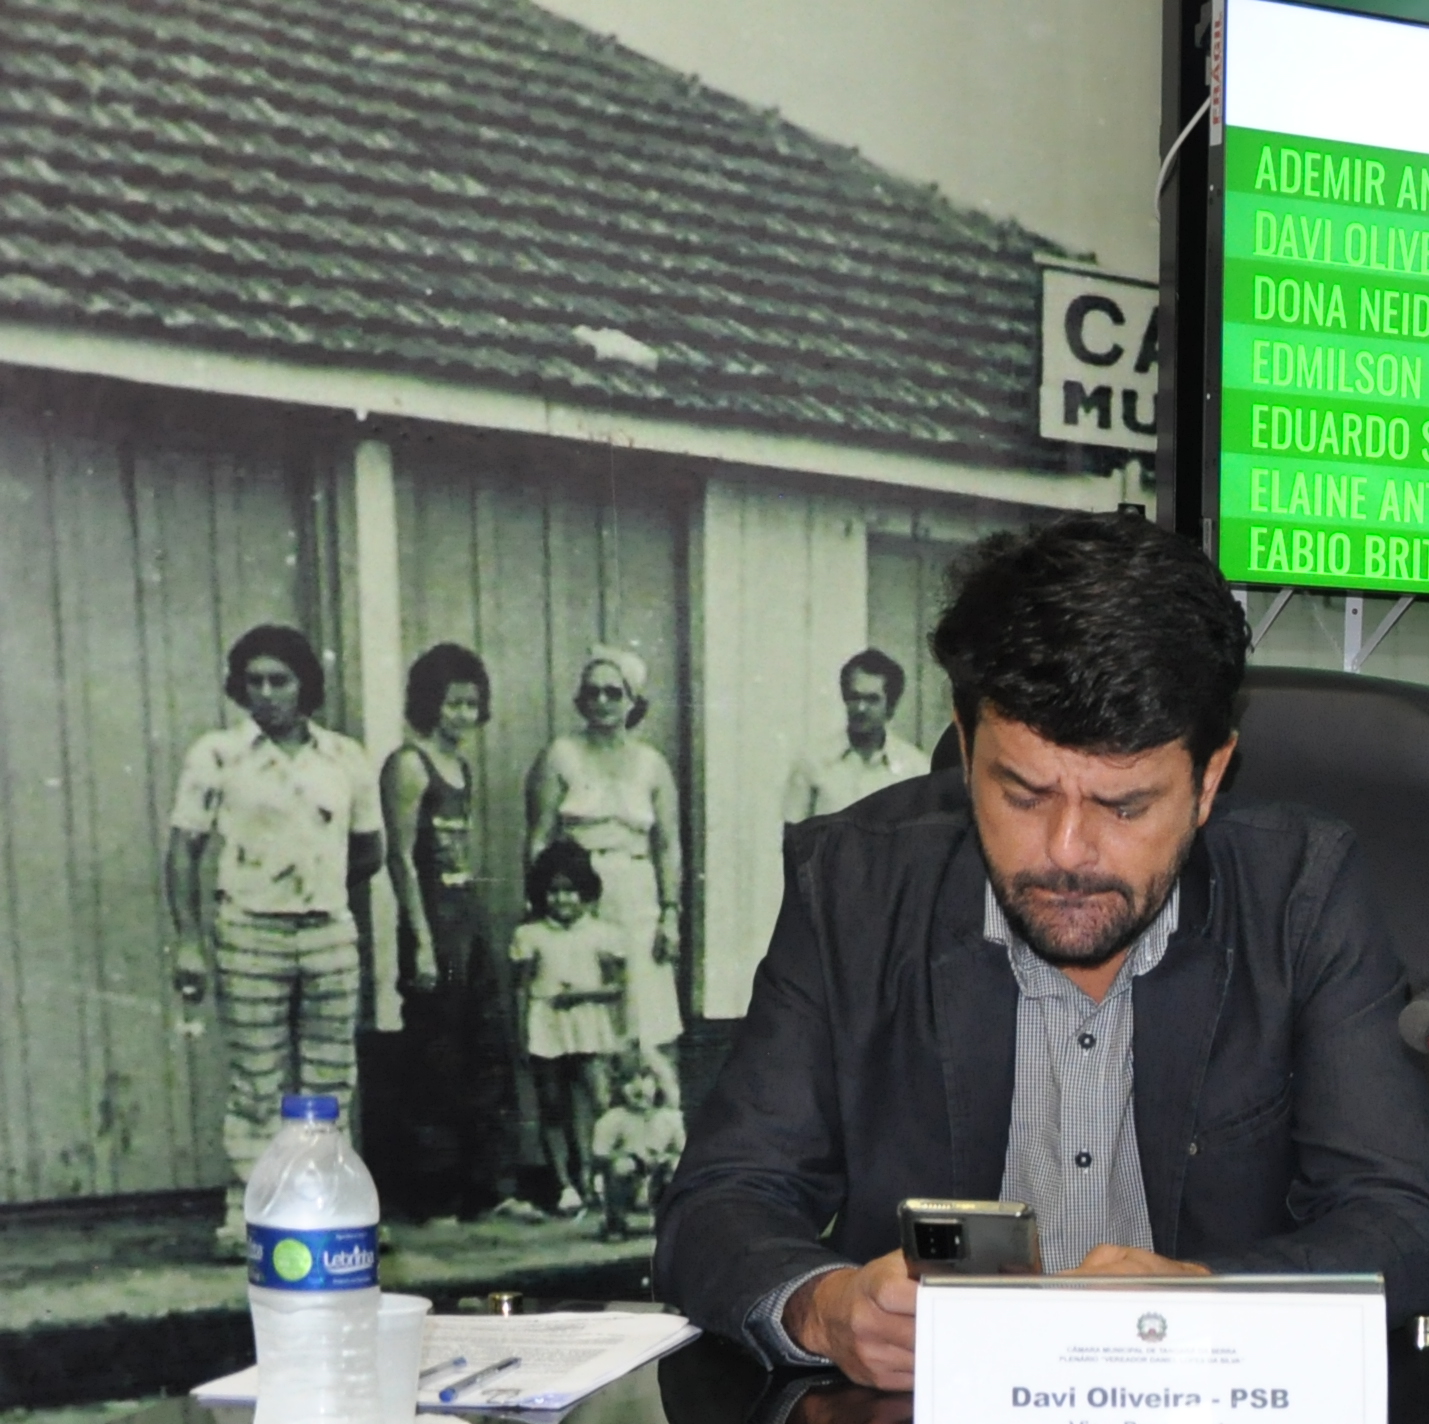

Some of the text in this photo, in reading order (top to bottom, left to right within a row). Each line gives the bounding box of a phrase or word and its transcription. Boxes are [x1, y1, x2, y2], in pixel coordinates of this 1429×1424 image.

[1254, 146, 1387, 208] ADEMIR
[1254, 210, 1335, 265] DAVI
[1253, 275, 1348, 330] DONA
[1252, 340, 1422, 400] EDMILSON
[1251, 404, 1411, 461] EDUARDO
[1250, 468, 1368, 521] ELAINE
[1248, 526, 1352, 577] FABIO
[1012, 1386, 1076, 1409] Davi
[1086, 1386, 1202, 1410] Oliveira
[1230, 1387, 1290, 1410] PSB
